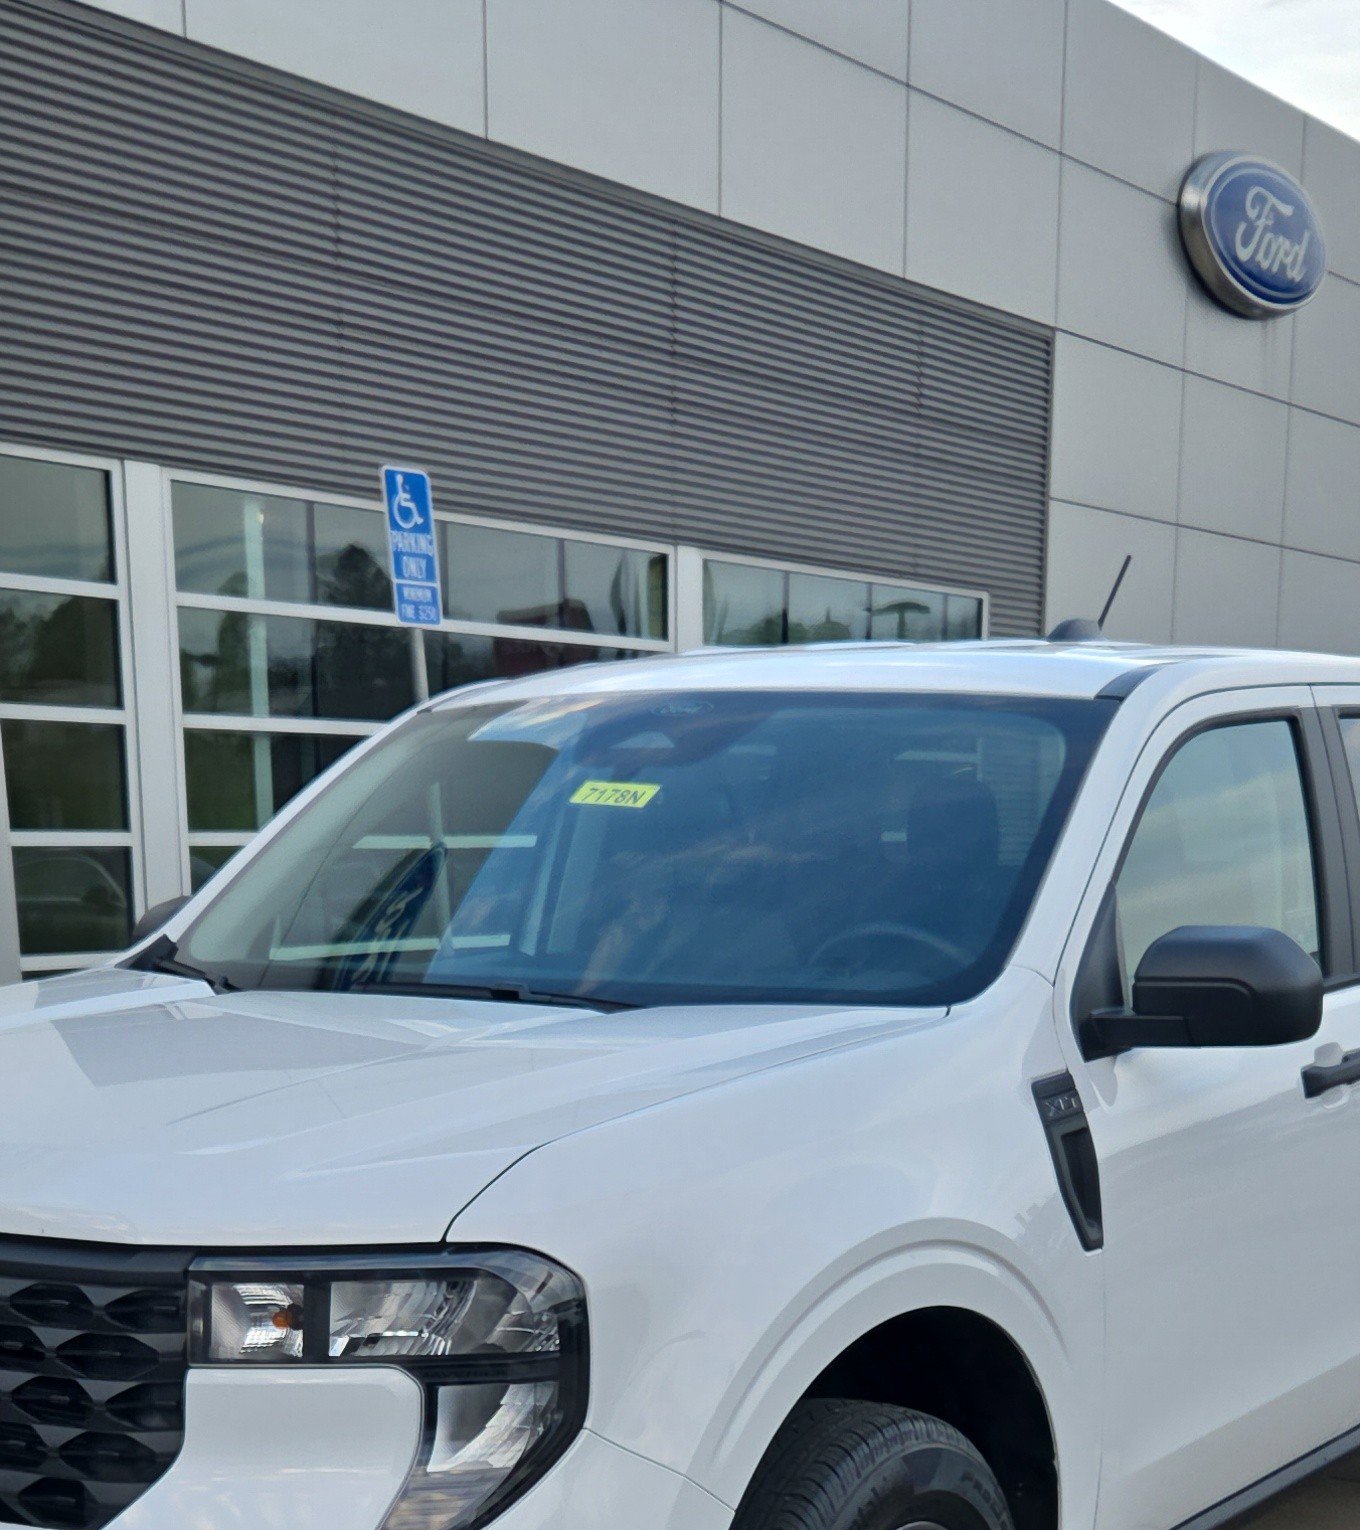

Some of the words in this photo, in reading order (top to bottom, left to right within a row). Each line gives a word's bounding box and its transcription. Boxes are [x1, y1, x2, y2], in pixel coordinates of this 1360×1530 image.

[1235, 185, 1310, 282] Ford
[391, 530, 434, 557] PARKING
[402, 555, 427, 580] ONLY
[582, 787, 646, 805] 7178N
